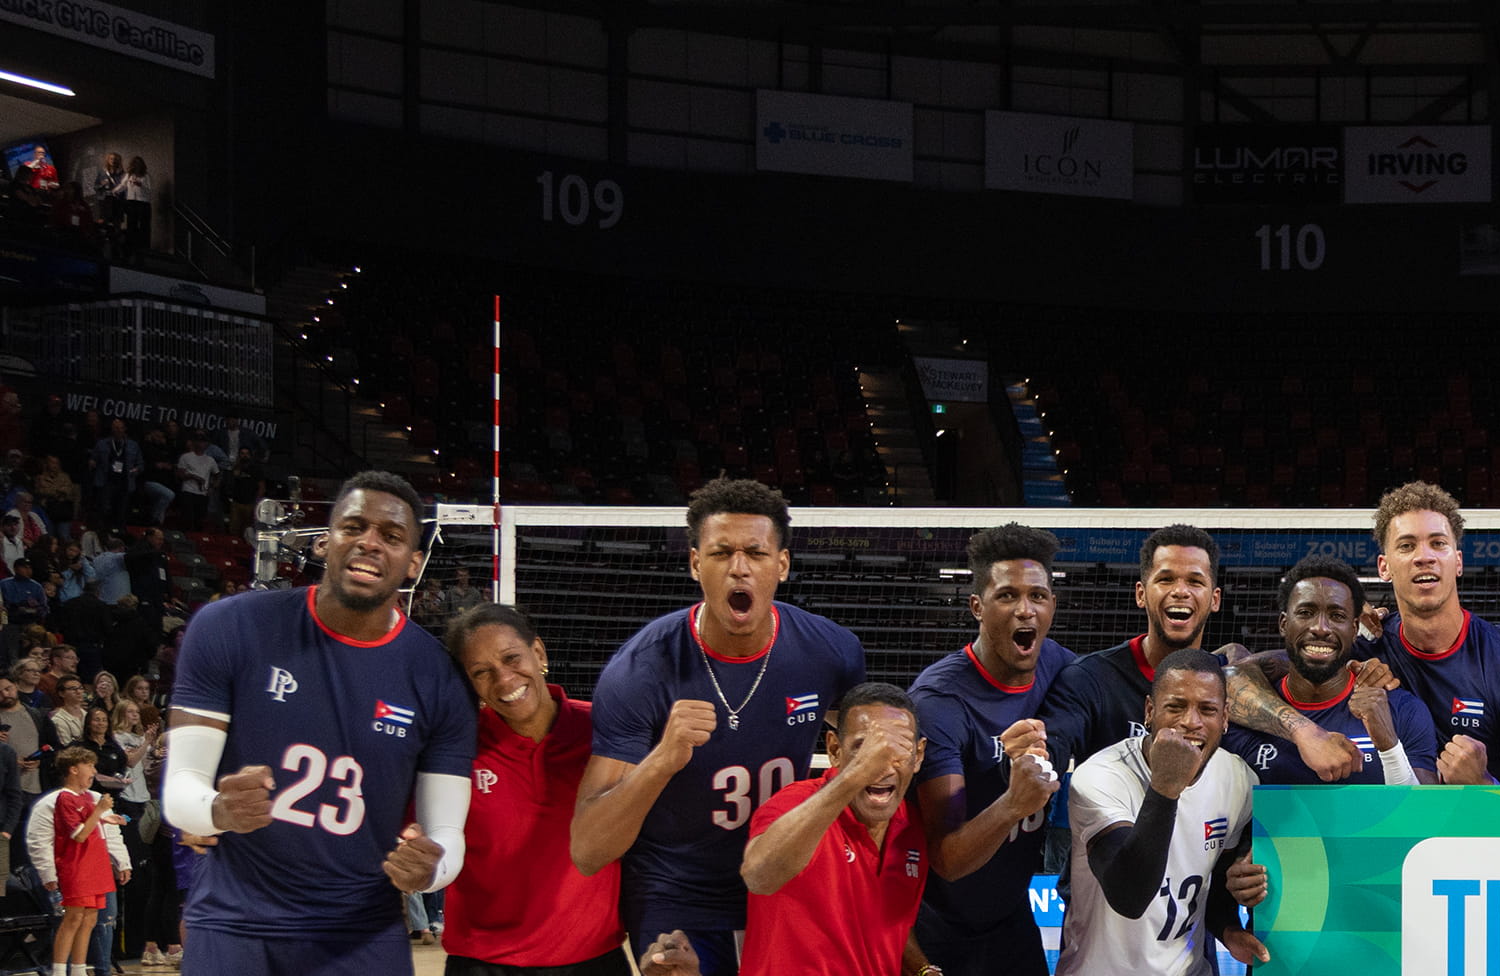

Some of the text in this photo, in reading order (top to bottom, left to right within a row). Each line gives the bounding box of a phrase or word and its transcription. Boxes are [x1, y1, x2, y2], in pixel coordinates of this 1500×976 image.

[57, 1, 110, 38] GMC
[112, 16, 205, 67] Cadillac
[788, 128, 836, 144] BLUE
[840, 133, 903, 149] CROSS
[1023, 153, 1102, 180] ICON
[1194, 146, 1339, 170] LUMAR
[1368, 152, 1468, 176] IRVING
[1193, 173, 1340, 184] ELECTRIC
[535, 169, 625, 230] 109
[1255, 223, 1327, 271] 110
[1305, 541, 1367, 559] ZONE
[374, 720, 407, 739] CUB
[787, 711, 817, 726] CUB
[1451, 716, 1480, 728] CUB
[270, 743, 366, 836] 23
[1156, 875, 1203, 941] 12
